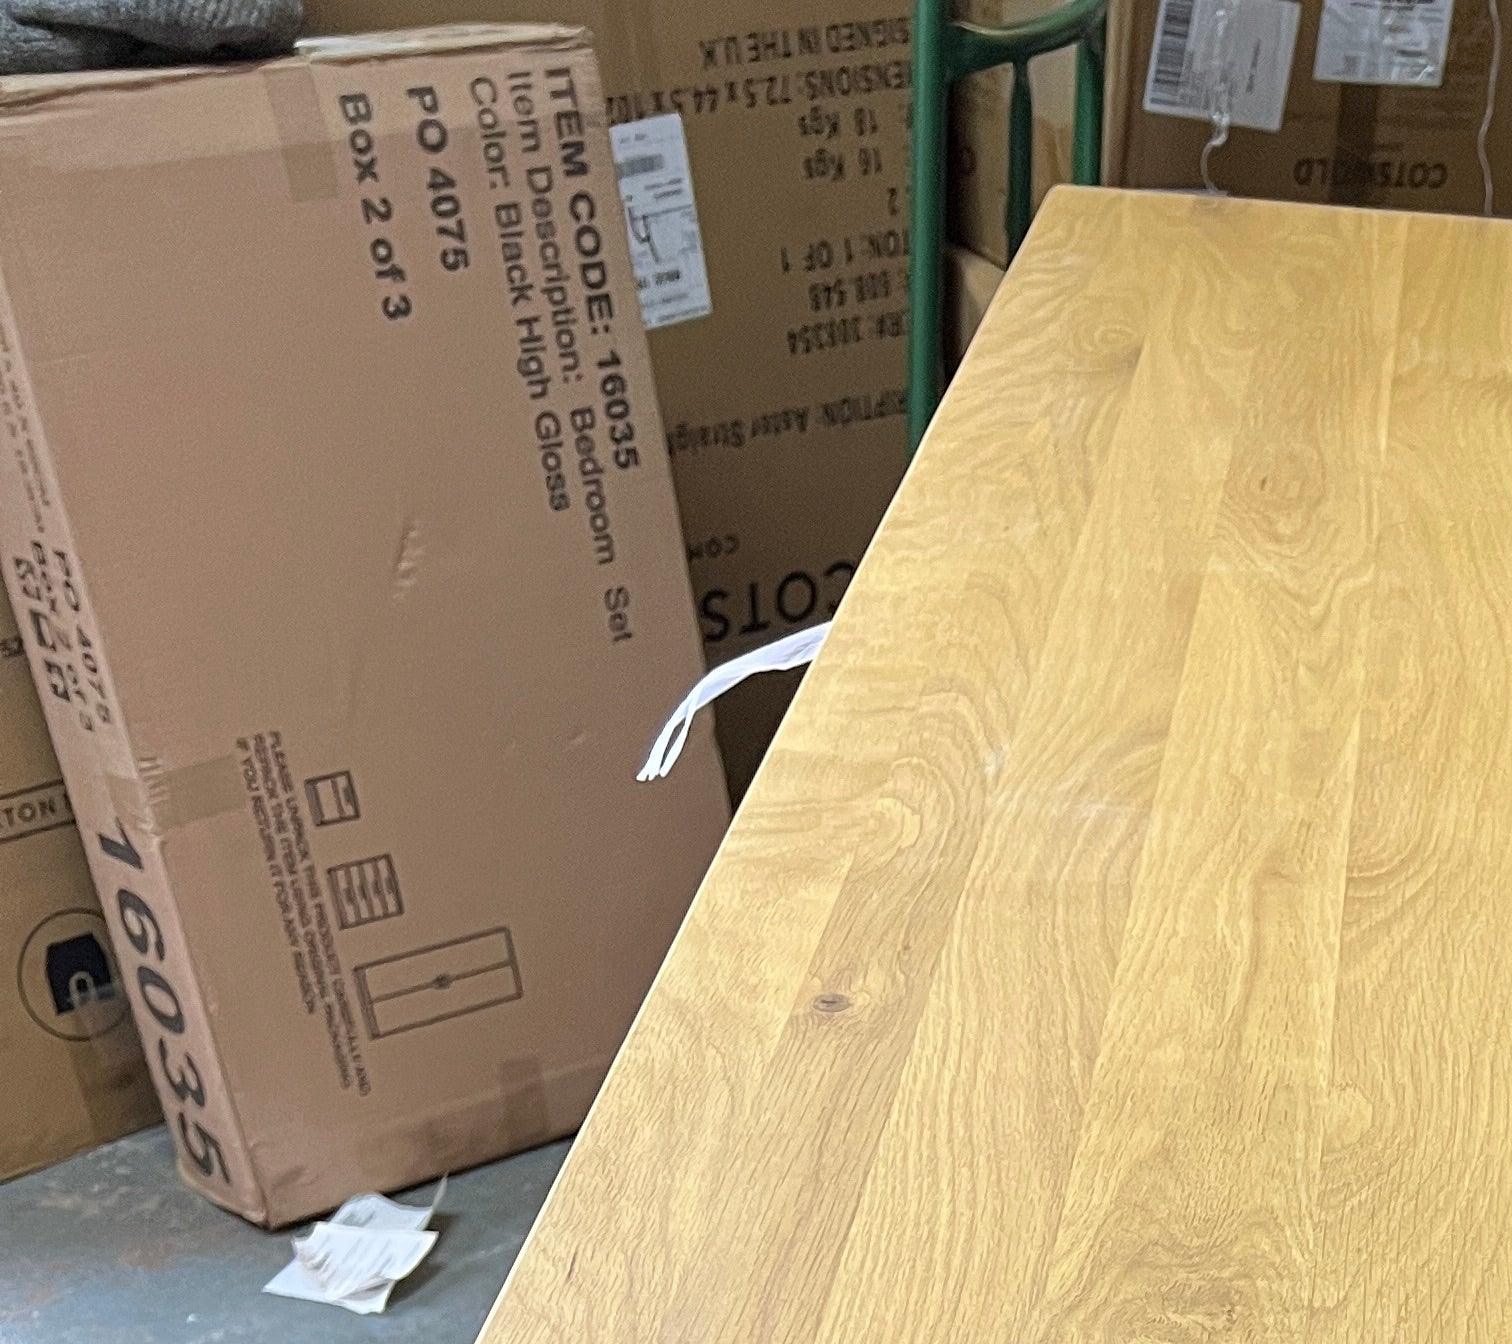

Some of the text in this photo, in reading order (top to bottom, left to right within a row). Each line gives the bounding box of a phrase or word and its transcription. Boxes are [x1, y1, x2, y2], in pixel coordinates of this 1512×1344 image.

[746, 30, 791, 63] THE
[338, 92, 413, 321] Box 2 of 3
[406, 86, 471, 272] PO 4075
[1293, 155, 1448, 190] COTSLD
[470, 77, 571, 513] Color: Black High Gloss
[508, 71, 633, 643] Item Description: Bedroom Set
[546, 67, 641, 470] ITEM CODE: 16035
[53, 550, 80, 613] PO
[700, 560, 852, 642] COTS
[0, 796, 56, 829] TON
[97, 815, 232, 1186] 16035
